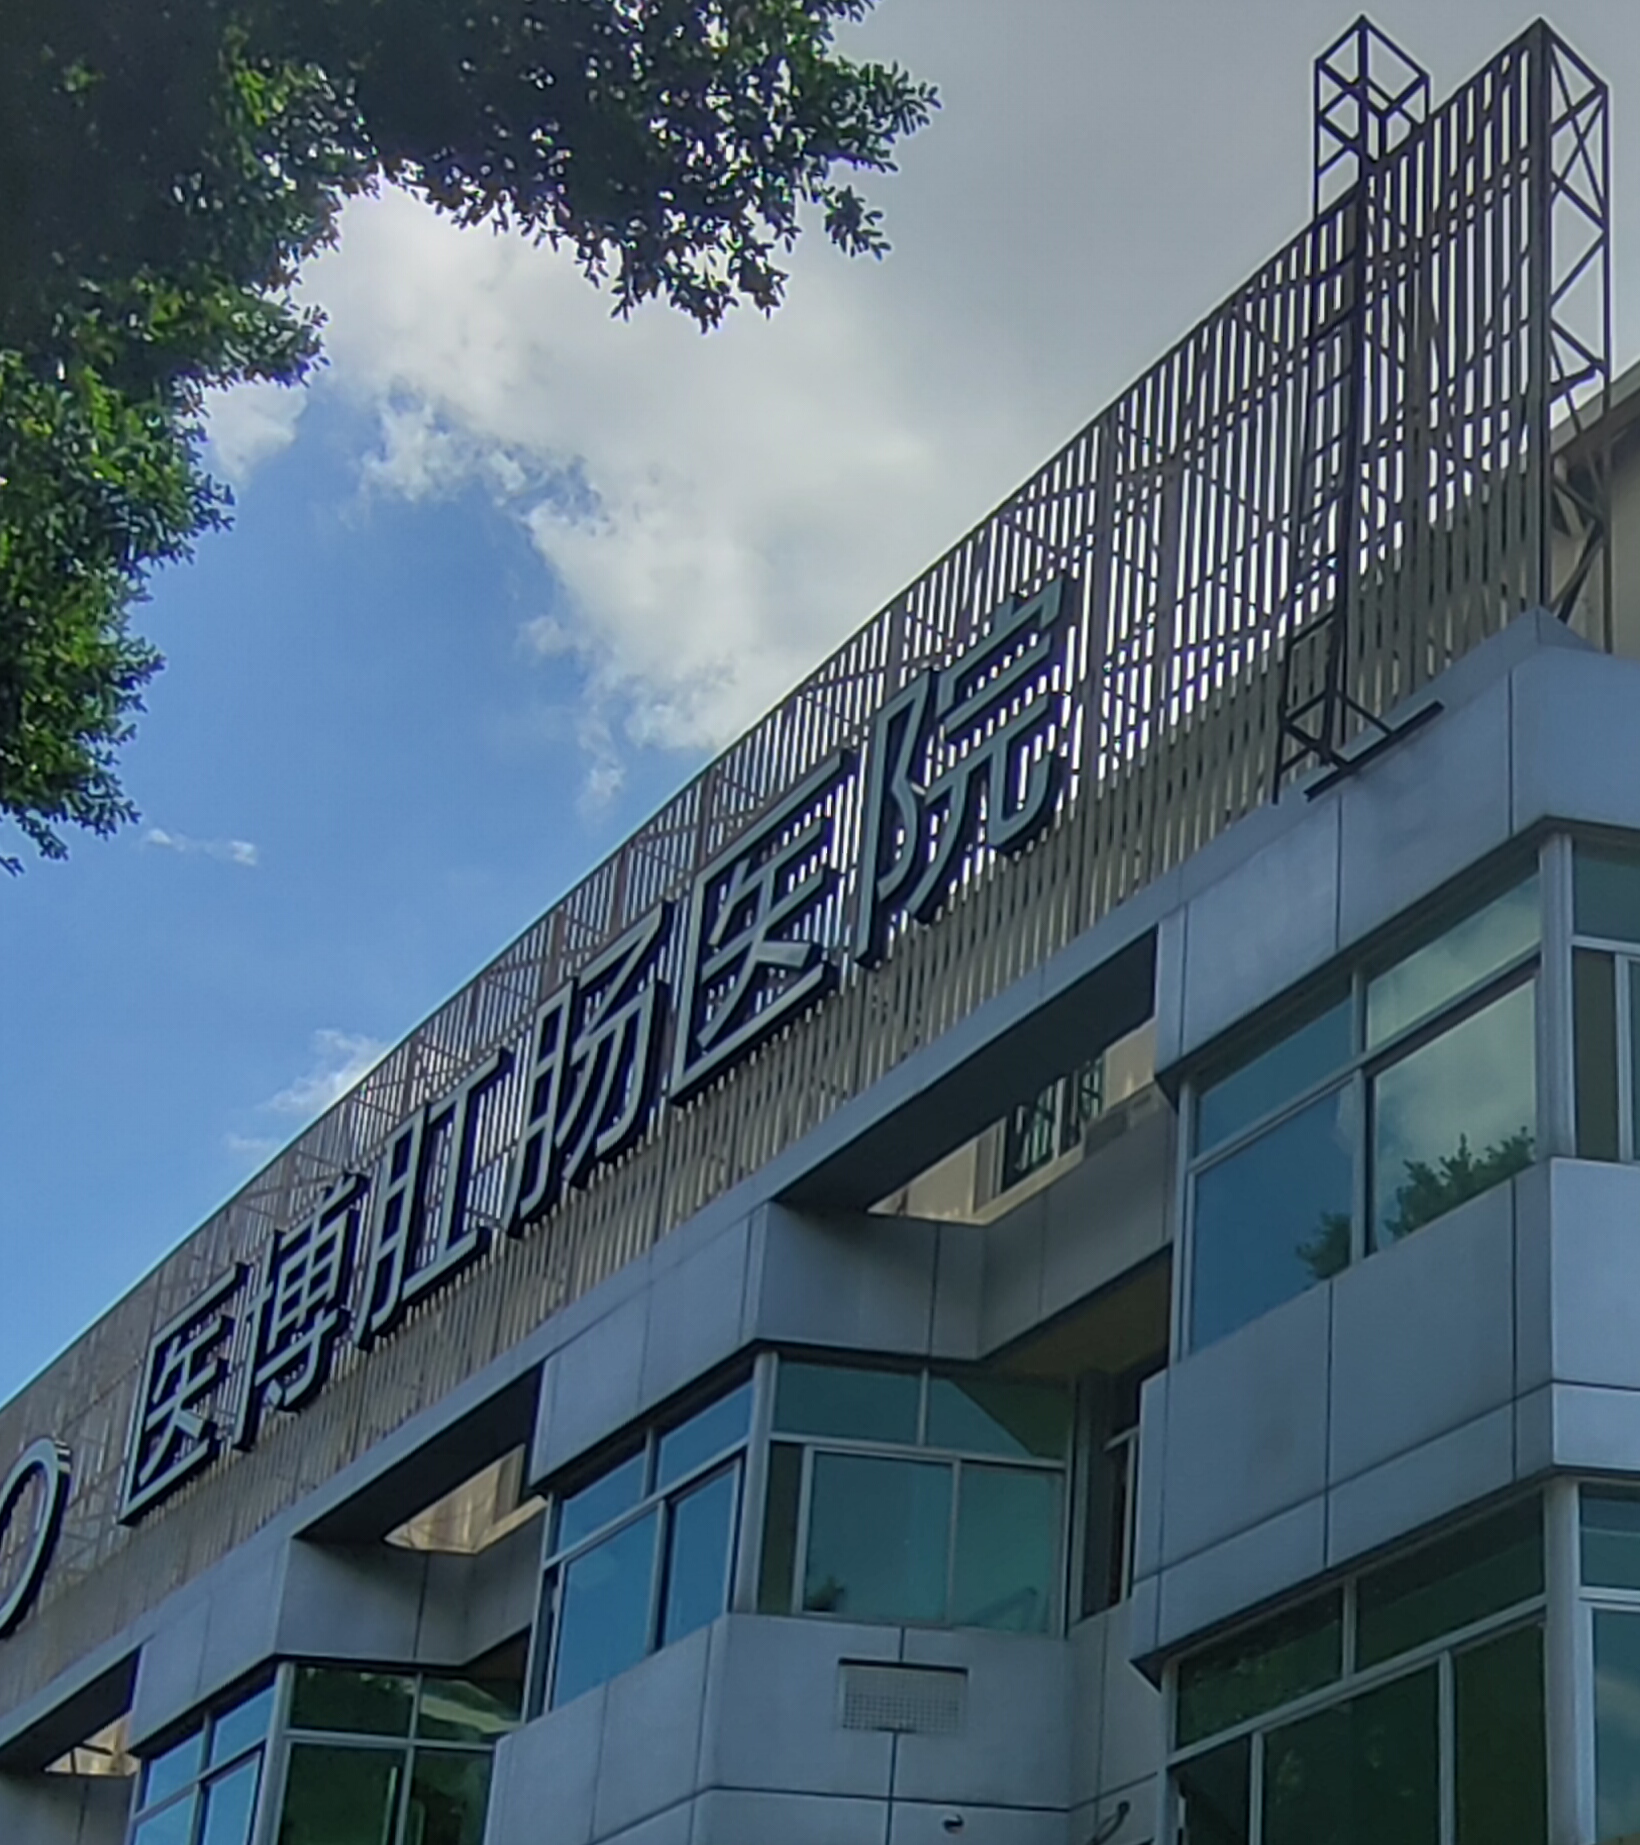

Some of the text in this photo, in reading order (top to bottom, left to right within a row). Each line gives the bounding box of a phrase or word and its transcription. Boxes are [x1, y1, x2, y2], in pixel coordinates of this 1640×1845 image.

[120, 577, 1079, 1525] 医博肛肠医院
